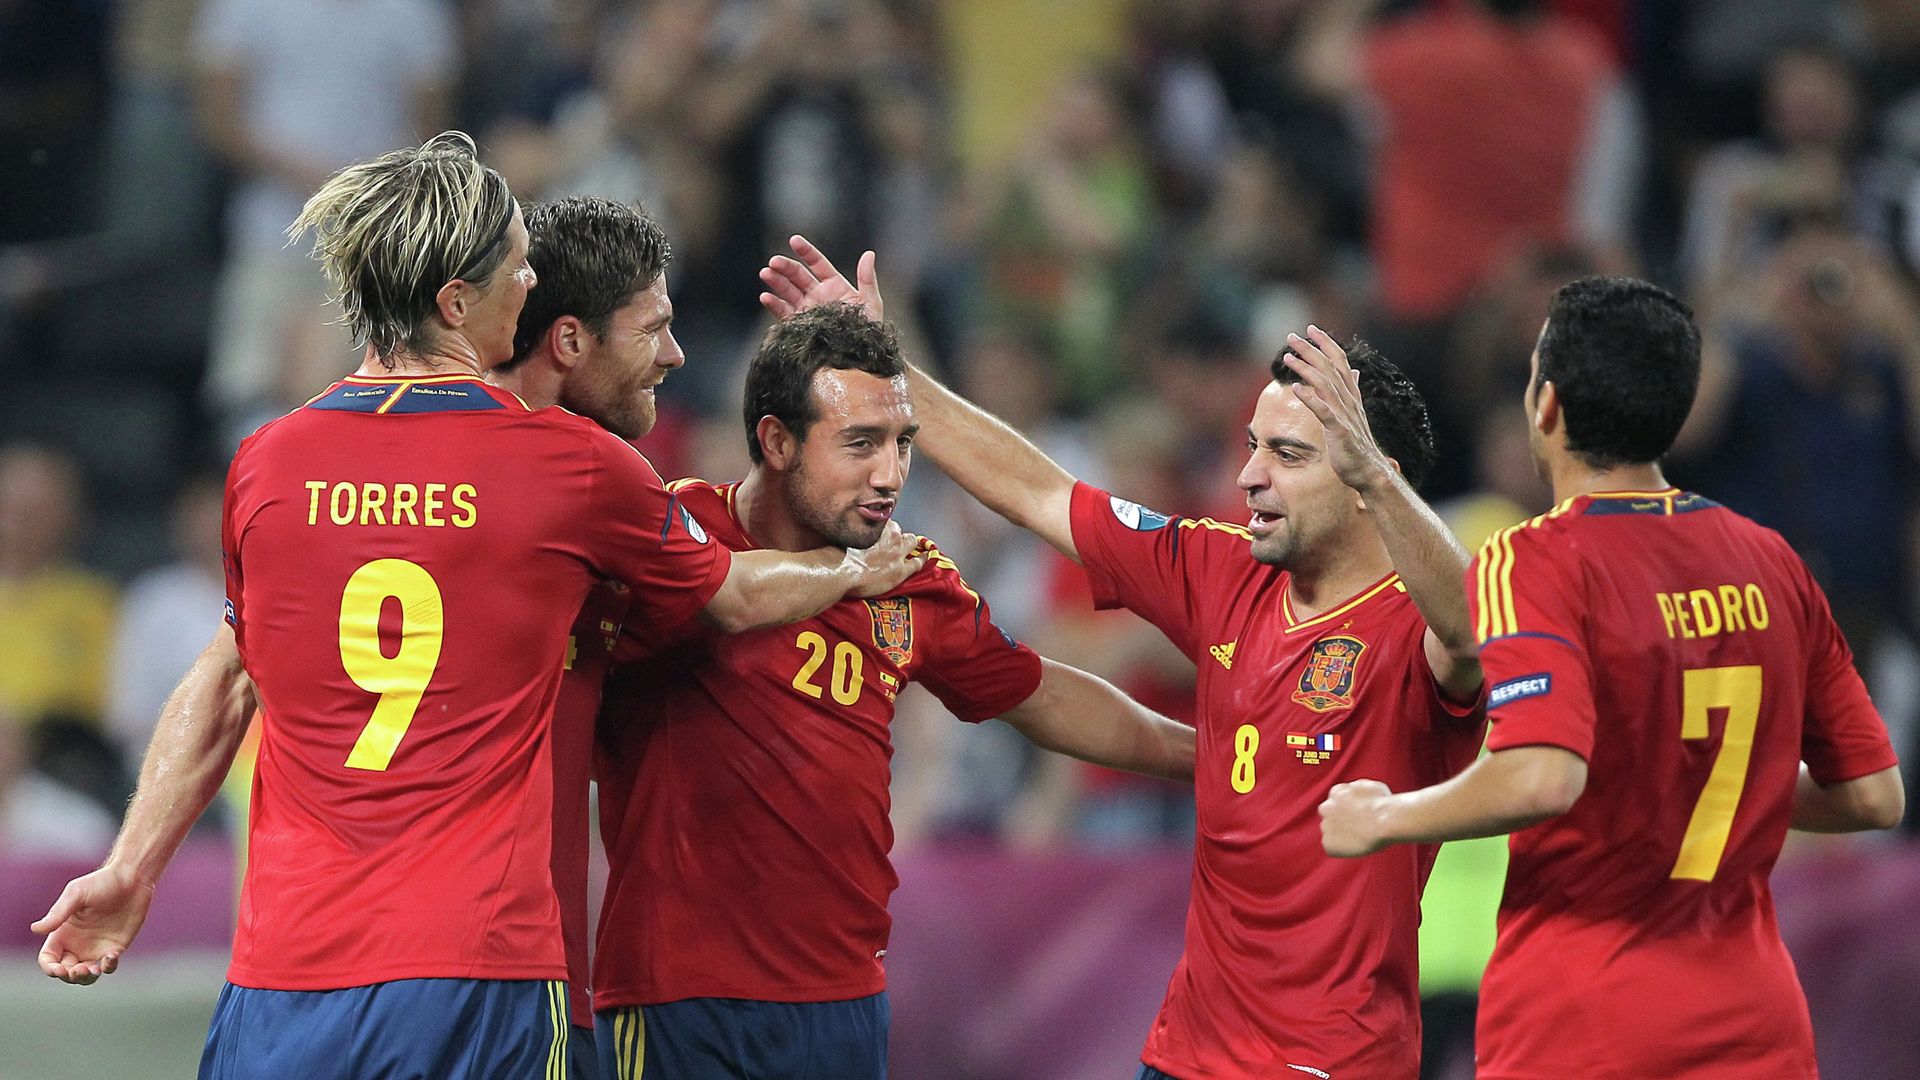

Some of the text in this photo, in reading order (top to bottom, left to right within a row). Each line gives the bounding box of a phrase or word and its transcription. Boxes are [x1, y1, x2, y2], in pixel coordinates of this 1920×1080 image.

[304, 480, 478, 529] TORRES
[1655, 583, 1770, 639] PEDRO
[338, 557, 444, 772] 9
[791, 630, 863, 706] 20
[1209, 645, 1233, 670] adas
[1490, 677, 1548, 702] RESPECT
[1231, 724, 1260, 794] 8
[1669, 665, 1763, 882] 7
